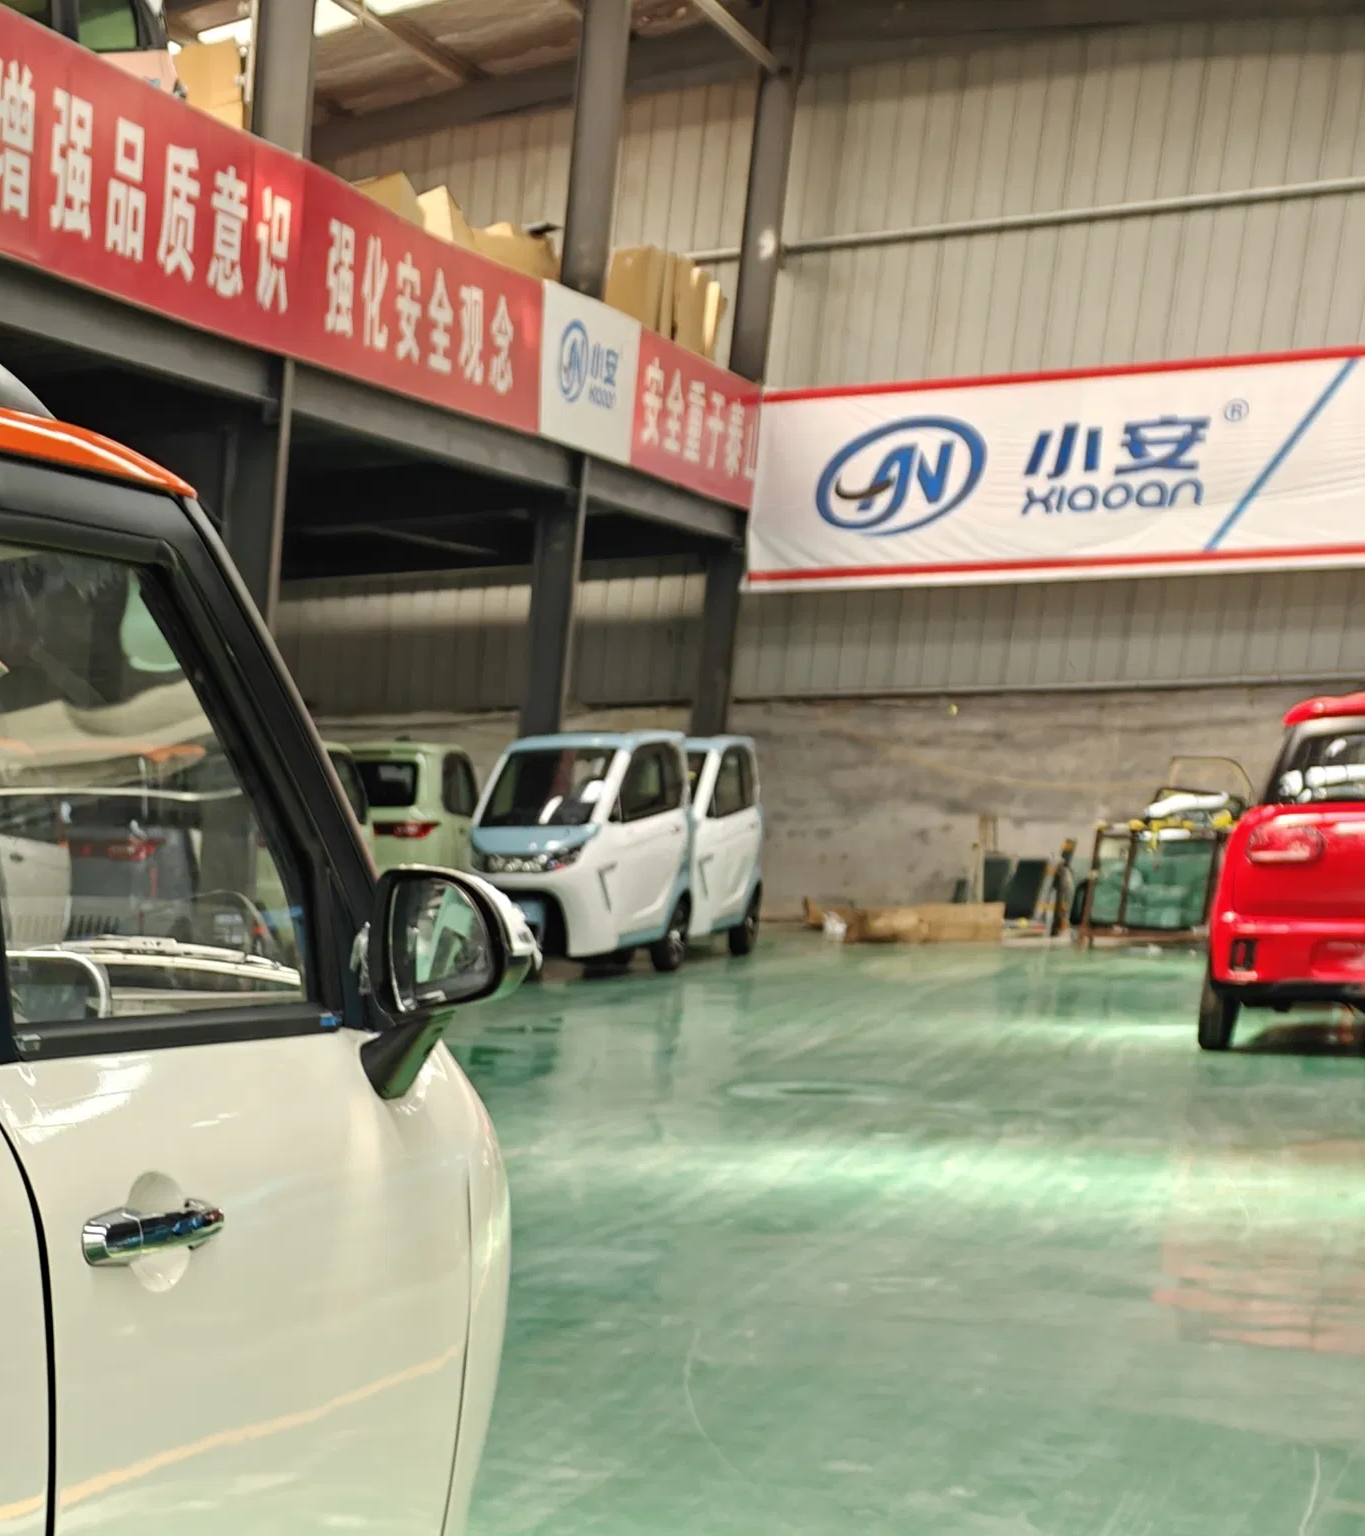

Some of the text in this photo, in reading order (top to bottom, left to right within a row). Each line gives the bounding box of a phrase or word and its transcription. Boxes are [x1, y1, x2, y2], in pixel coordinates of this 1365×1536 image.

[324, 216, 515, 396] 强化安全观念
[1023, 415, 1211, 480] 小安
